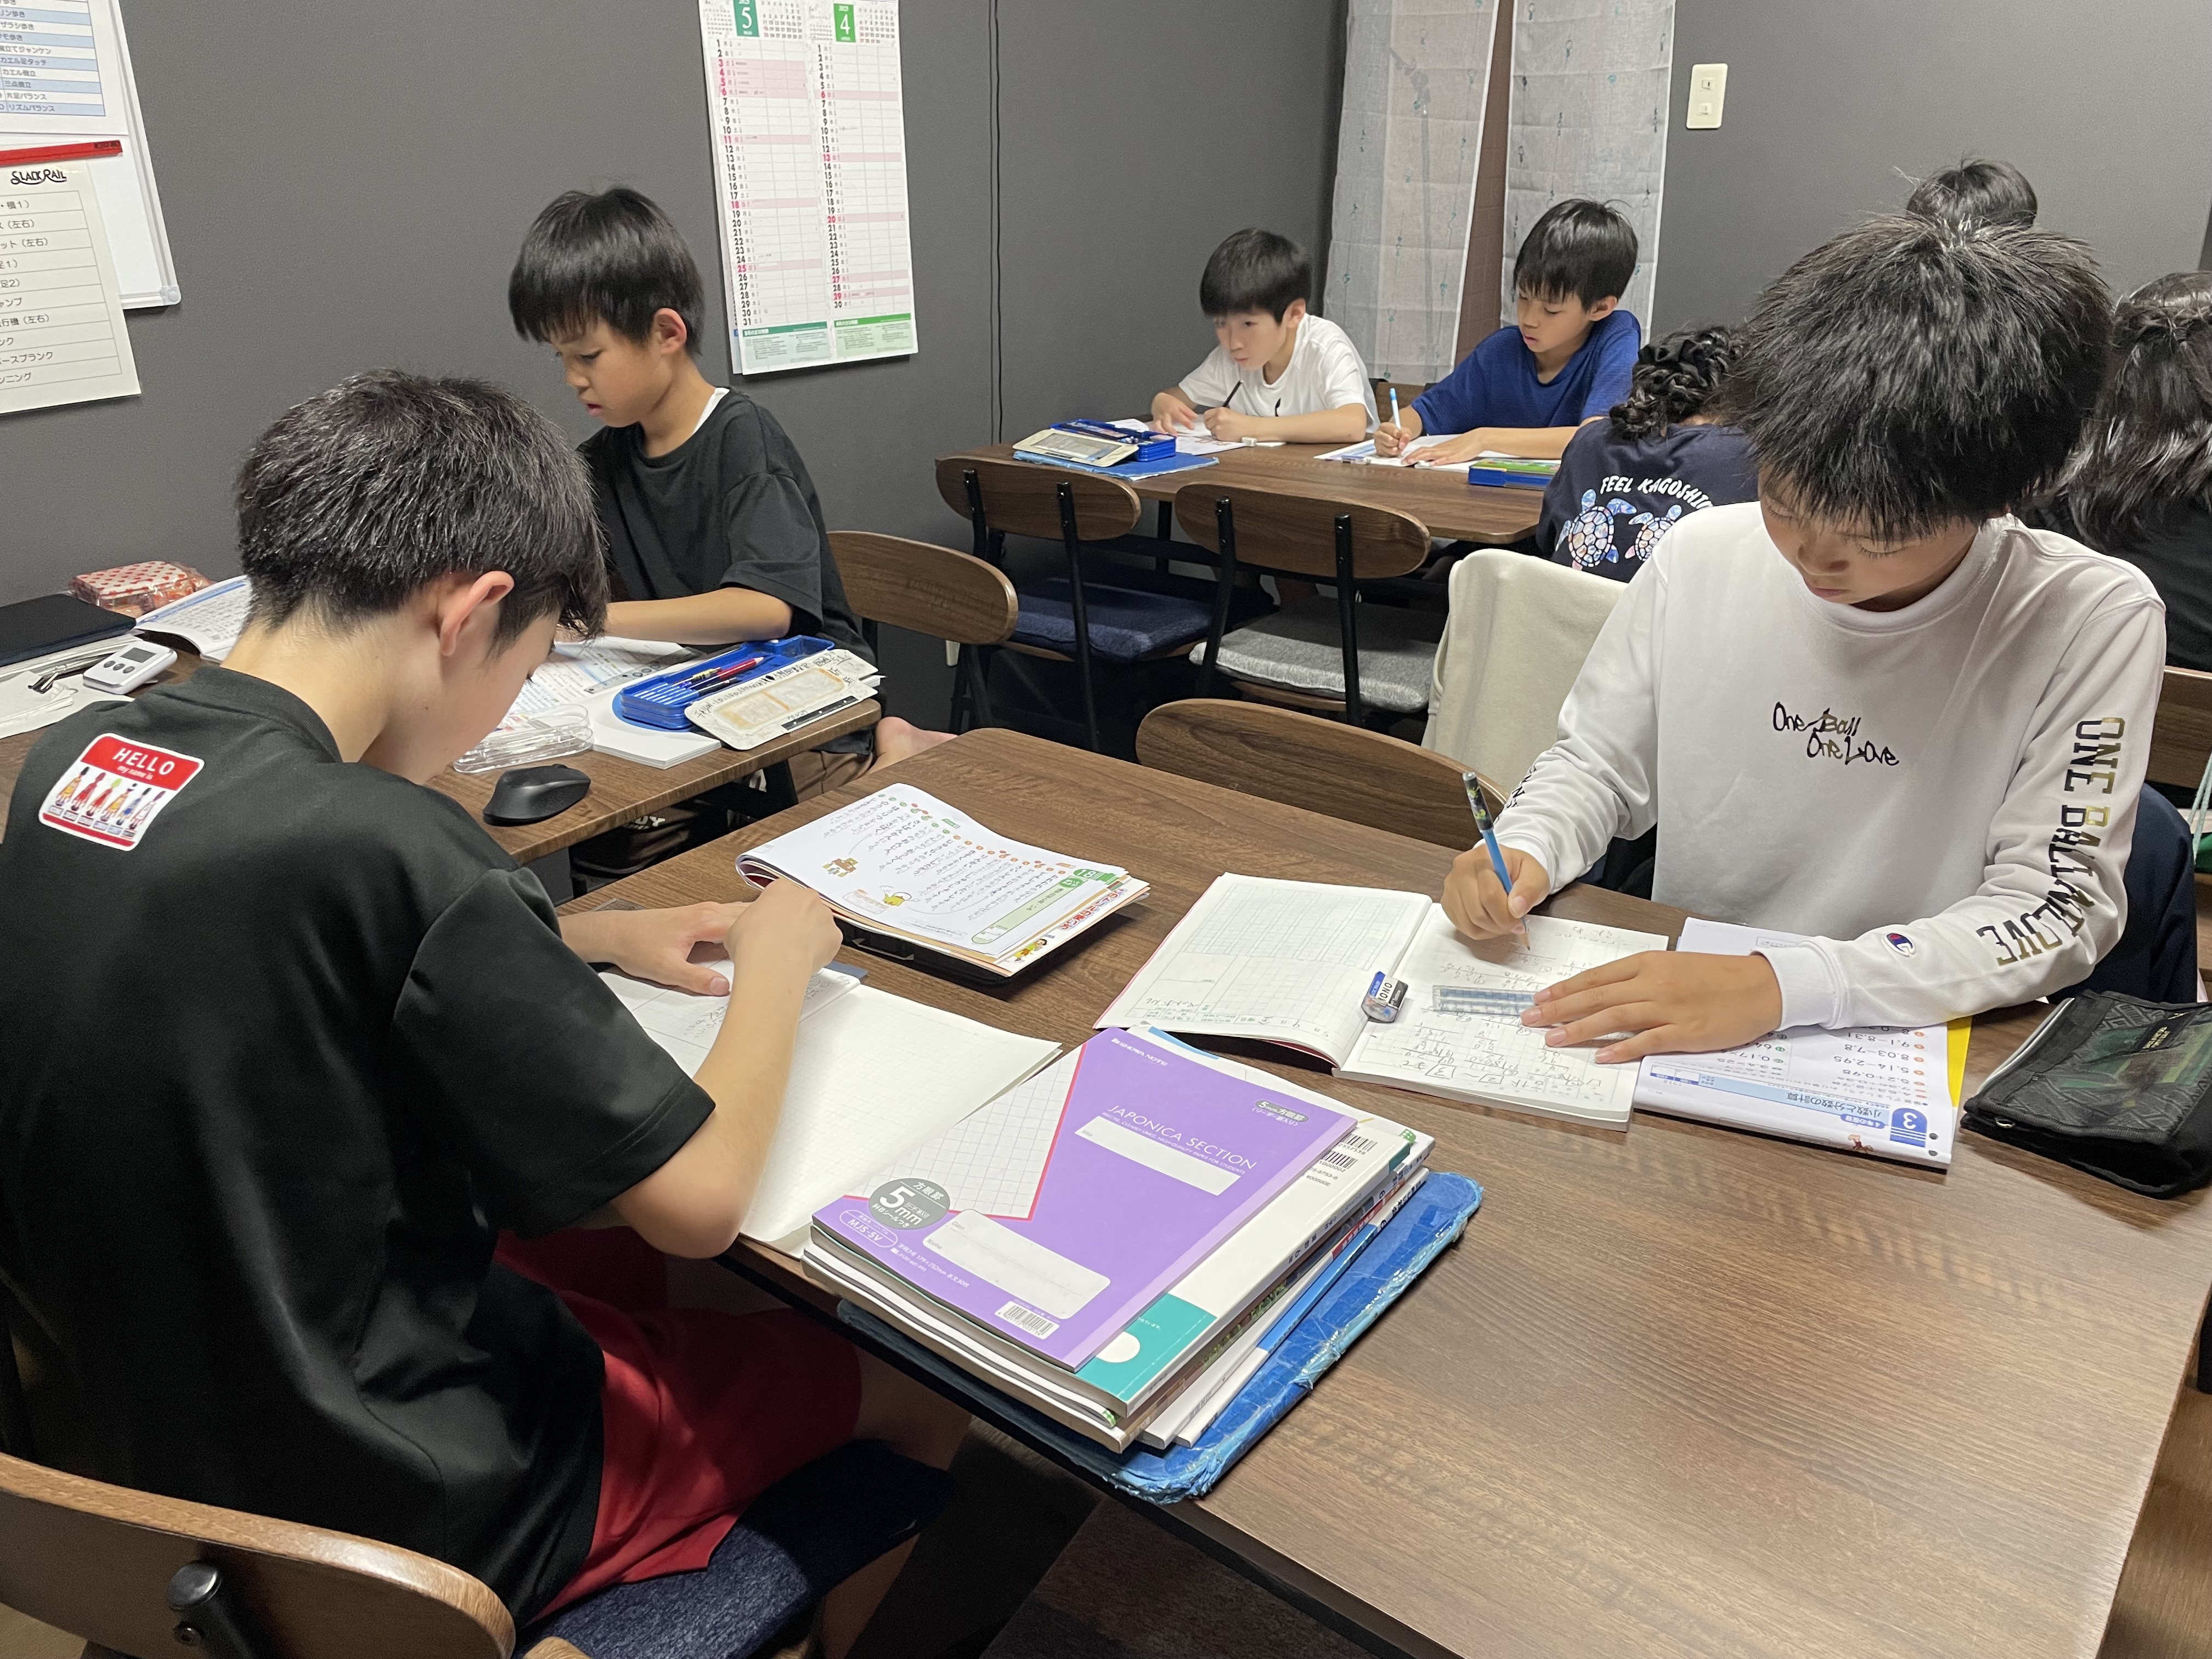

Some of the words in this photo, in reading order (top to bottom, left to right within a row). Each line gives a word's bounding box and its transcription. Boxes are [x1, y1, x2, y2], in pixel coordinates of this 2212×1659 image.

[742, 7, 752, 29] 5
[840, 14, 850, 35] 4
[720, 77, 726, 86] 5
[721, 88, 727, 96] 6
[737, 264, 746, 273] 25
[0, 352, 53, 364] ースプランク
[1600, 475, 1633, 494] FEEL
[112, 748, 175, 775] HELLO
[2064, 717, 2125, 794] ONE
[1078, 869, 1097, 878] 18
[1145, 1054, 1168, 1066] NOTE
[1844, 1044, 1909, 1060] 8.03-7.8
[1834, 1056, 1909, 1073] 5.14-2.95
[1903, 1112, 1918, 1130] 3
[1108, 1105, 1181, 1141] JAPONICA
[1186, 1138, 1257, 1170] SECTION
[1193, 1152, 1209, 1160] PAPER
[1220, 1162, 1246, 1175] STUDENTS
[848, 1219, 883, 1241] MJS-5V
